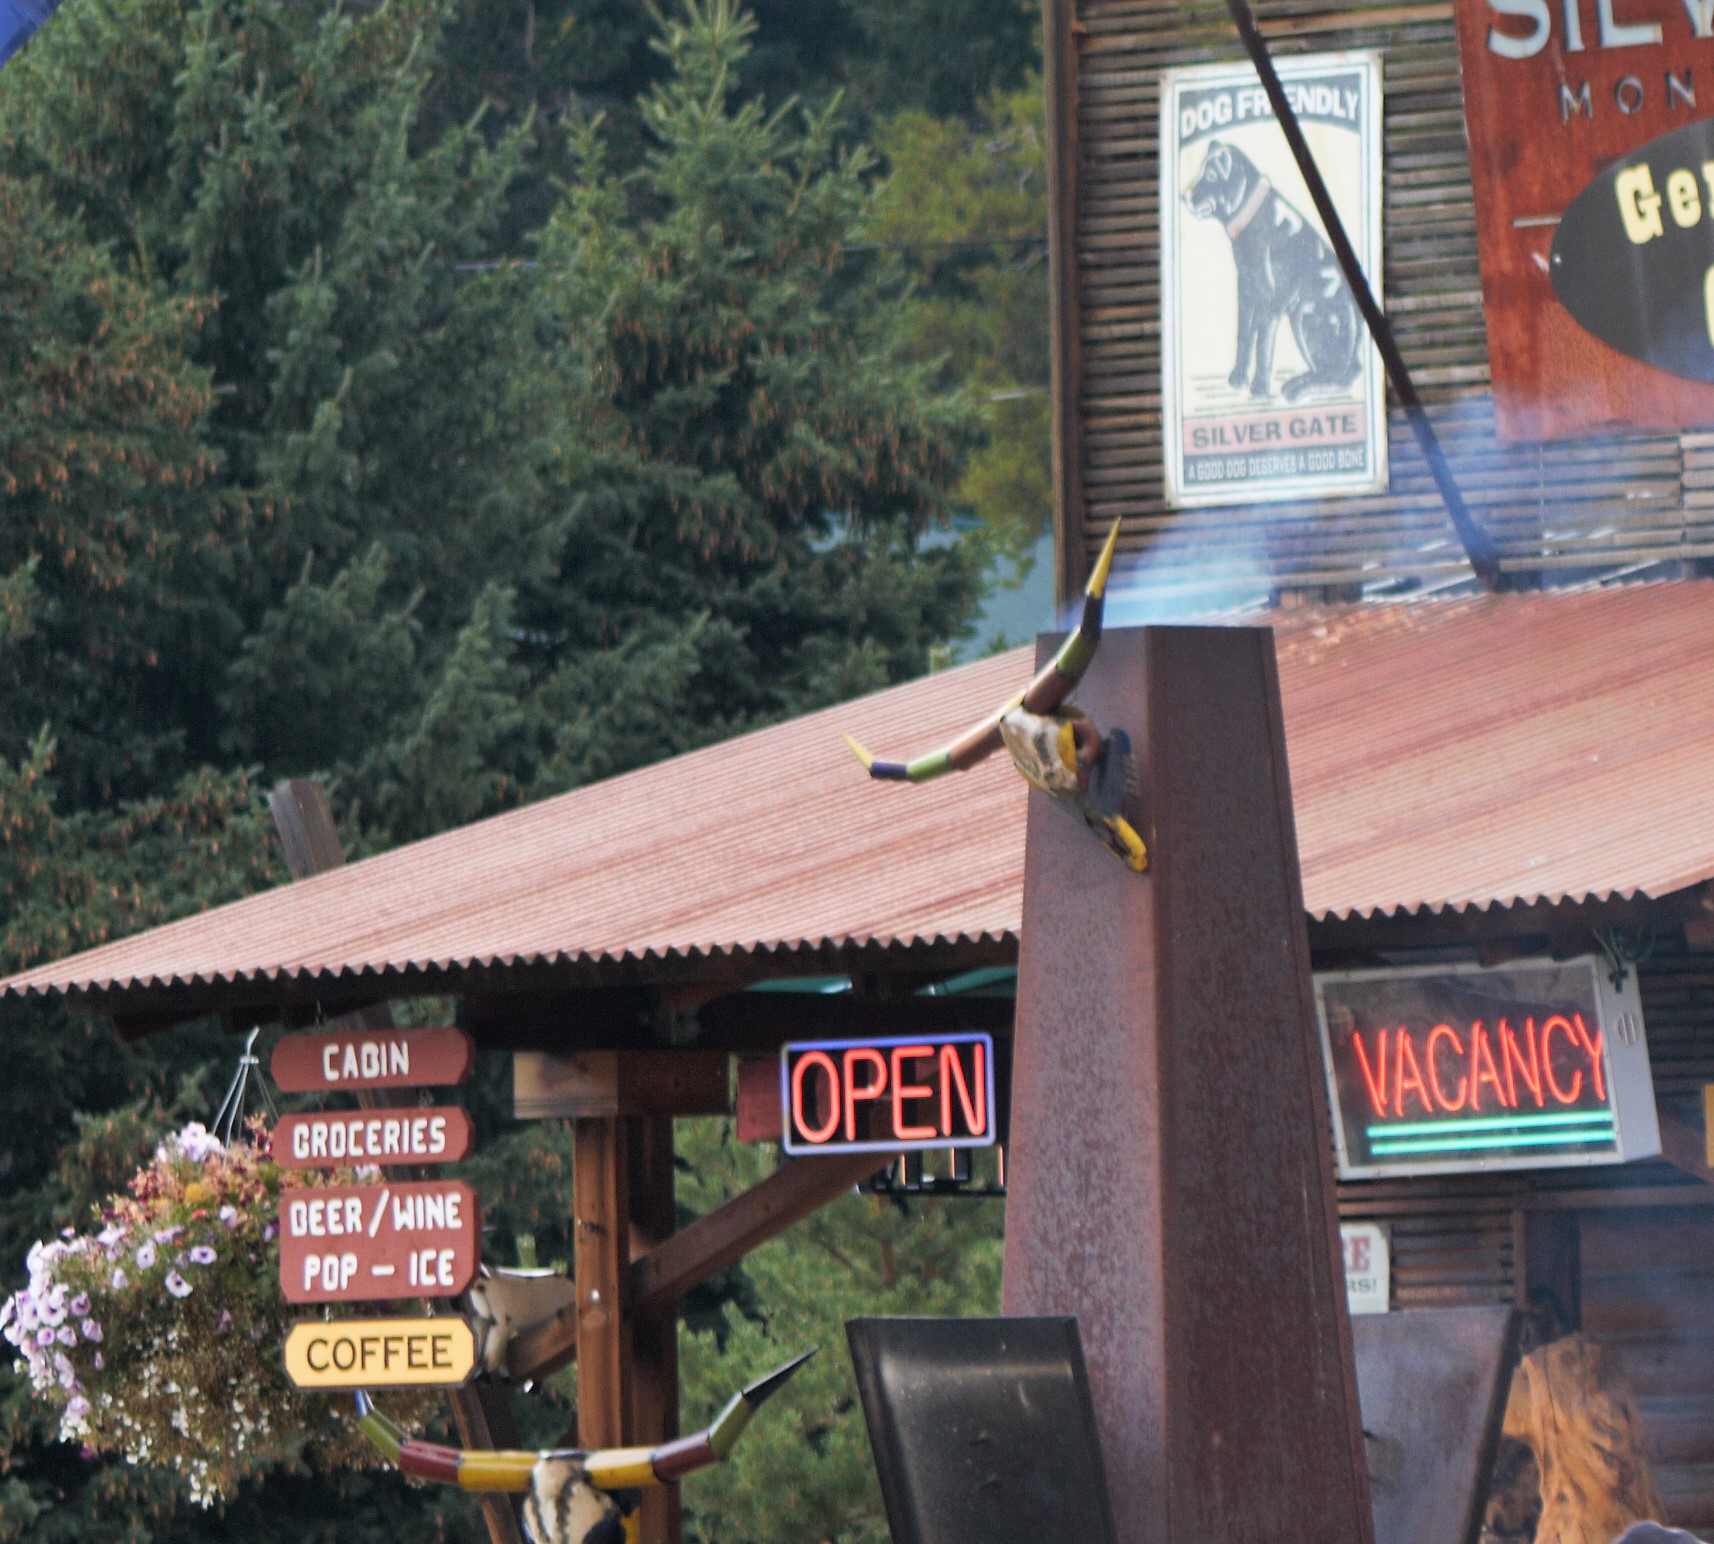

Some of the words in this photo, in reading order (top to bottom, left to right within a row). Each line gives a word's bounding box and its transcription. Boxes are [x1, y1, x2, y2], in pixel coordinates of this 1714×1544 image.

[1181, 94, 1233, 138] DOG
[1192, 420, 1282, 449] SILVER
[1289, 414, 1358, 438] GATE
[323, 1040, 410, 1081] CABIN
[1353, 1013, 1607, 1117] VACANCY
[791, 1044, 987, 1143] OPEN
[293, 1116, 446, 1159] GROCERIES
[304, 1253, 358, 1292] POP
[409, 1250, 455, 1287] ICE
[306, 1335, 454, 1372] COFFEE
